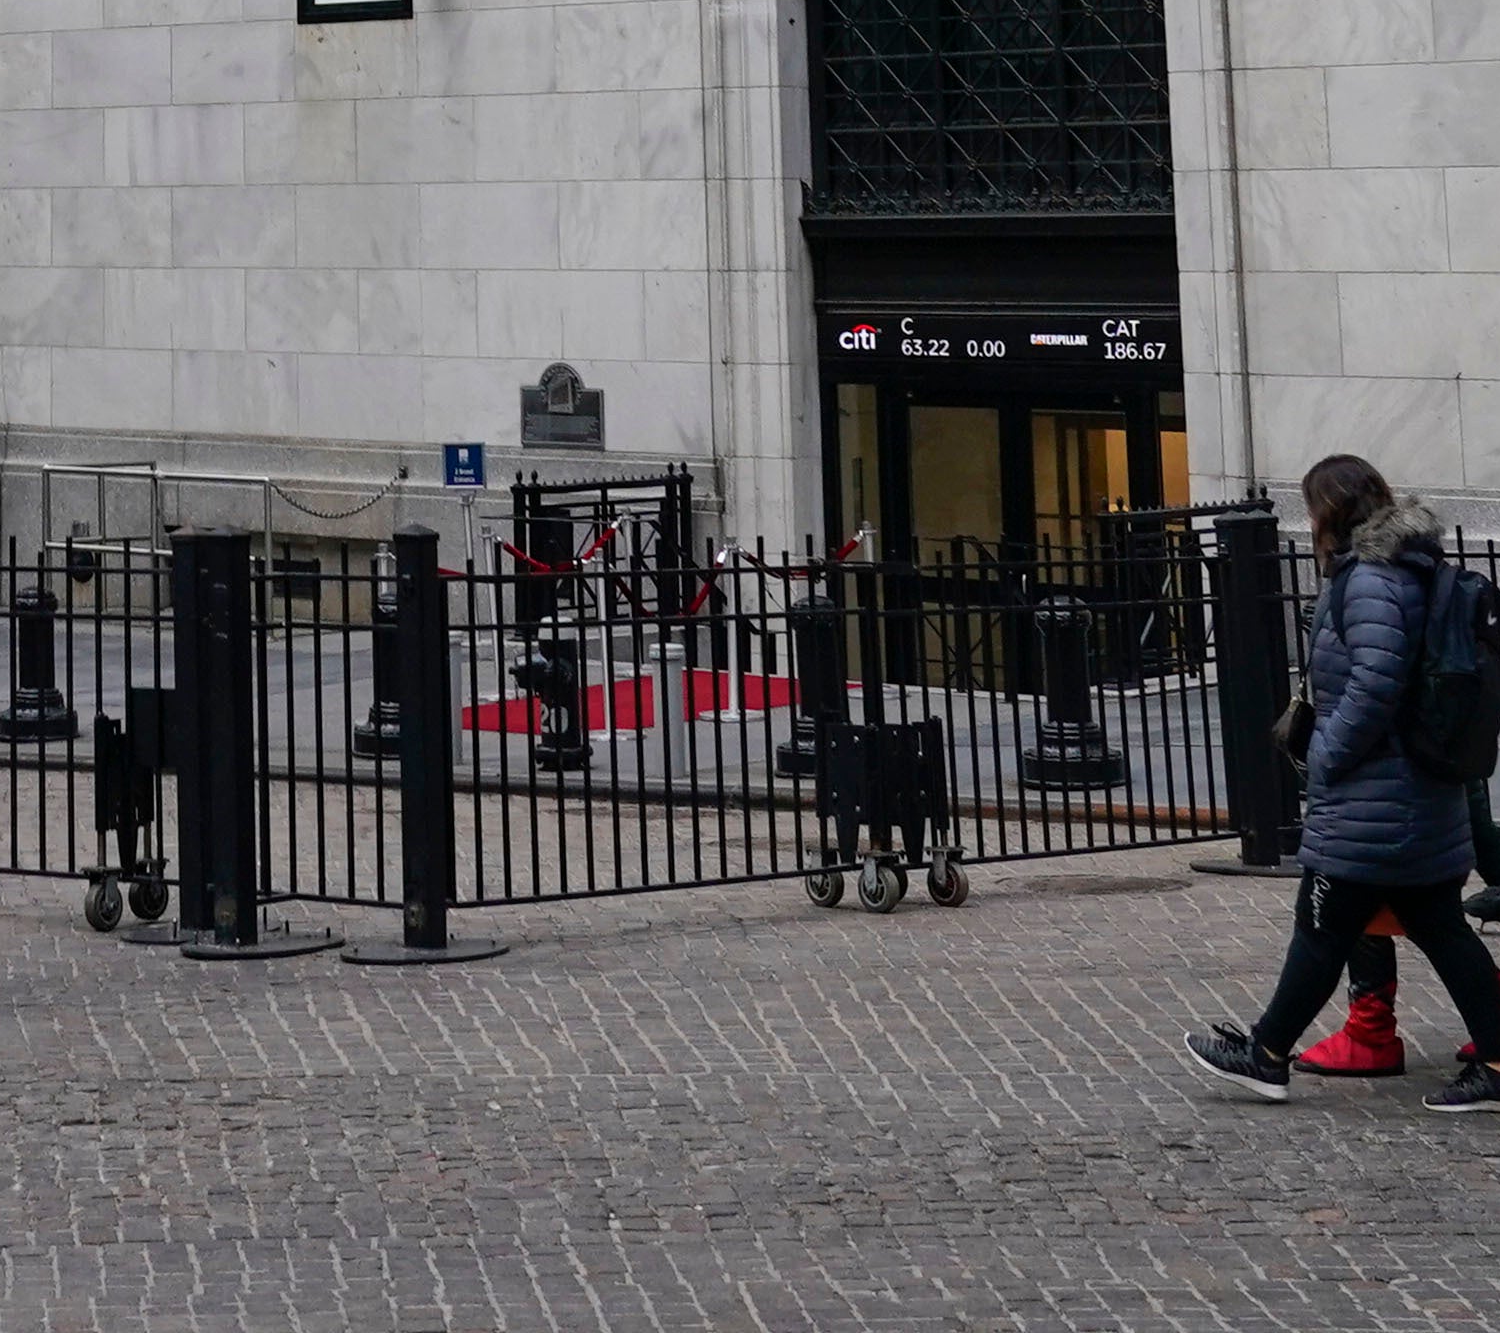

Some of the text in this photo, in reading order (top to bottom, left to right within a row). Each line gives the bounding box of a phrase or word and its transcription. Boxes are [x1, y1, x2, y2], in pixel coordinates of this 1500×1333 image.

[900, 317, 914, 335] C
[1102, 319, 1141, 338] CAT
[839, 324, 877, 350] citi
[1030, 333, 1089, 346] CATERPILLAR
[901, 338, 1006, 358] 63.22 0.00
[1103, 342, 1167, 360] 186.67
[540, 702, 569, 734] 20
